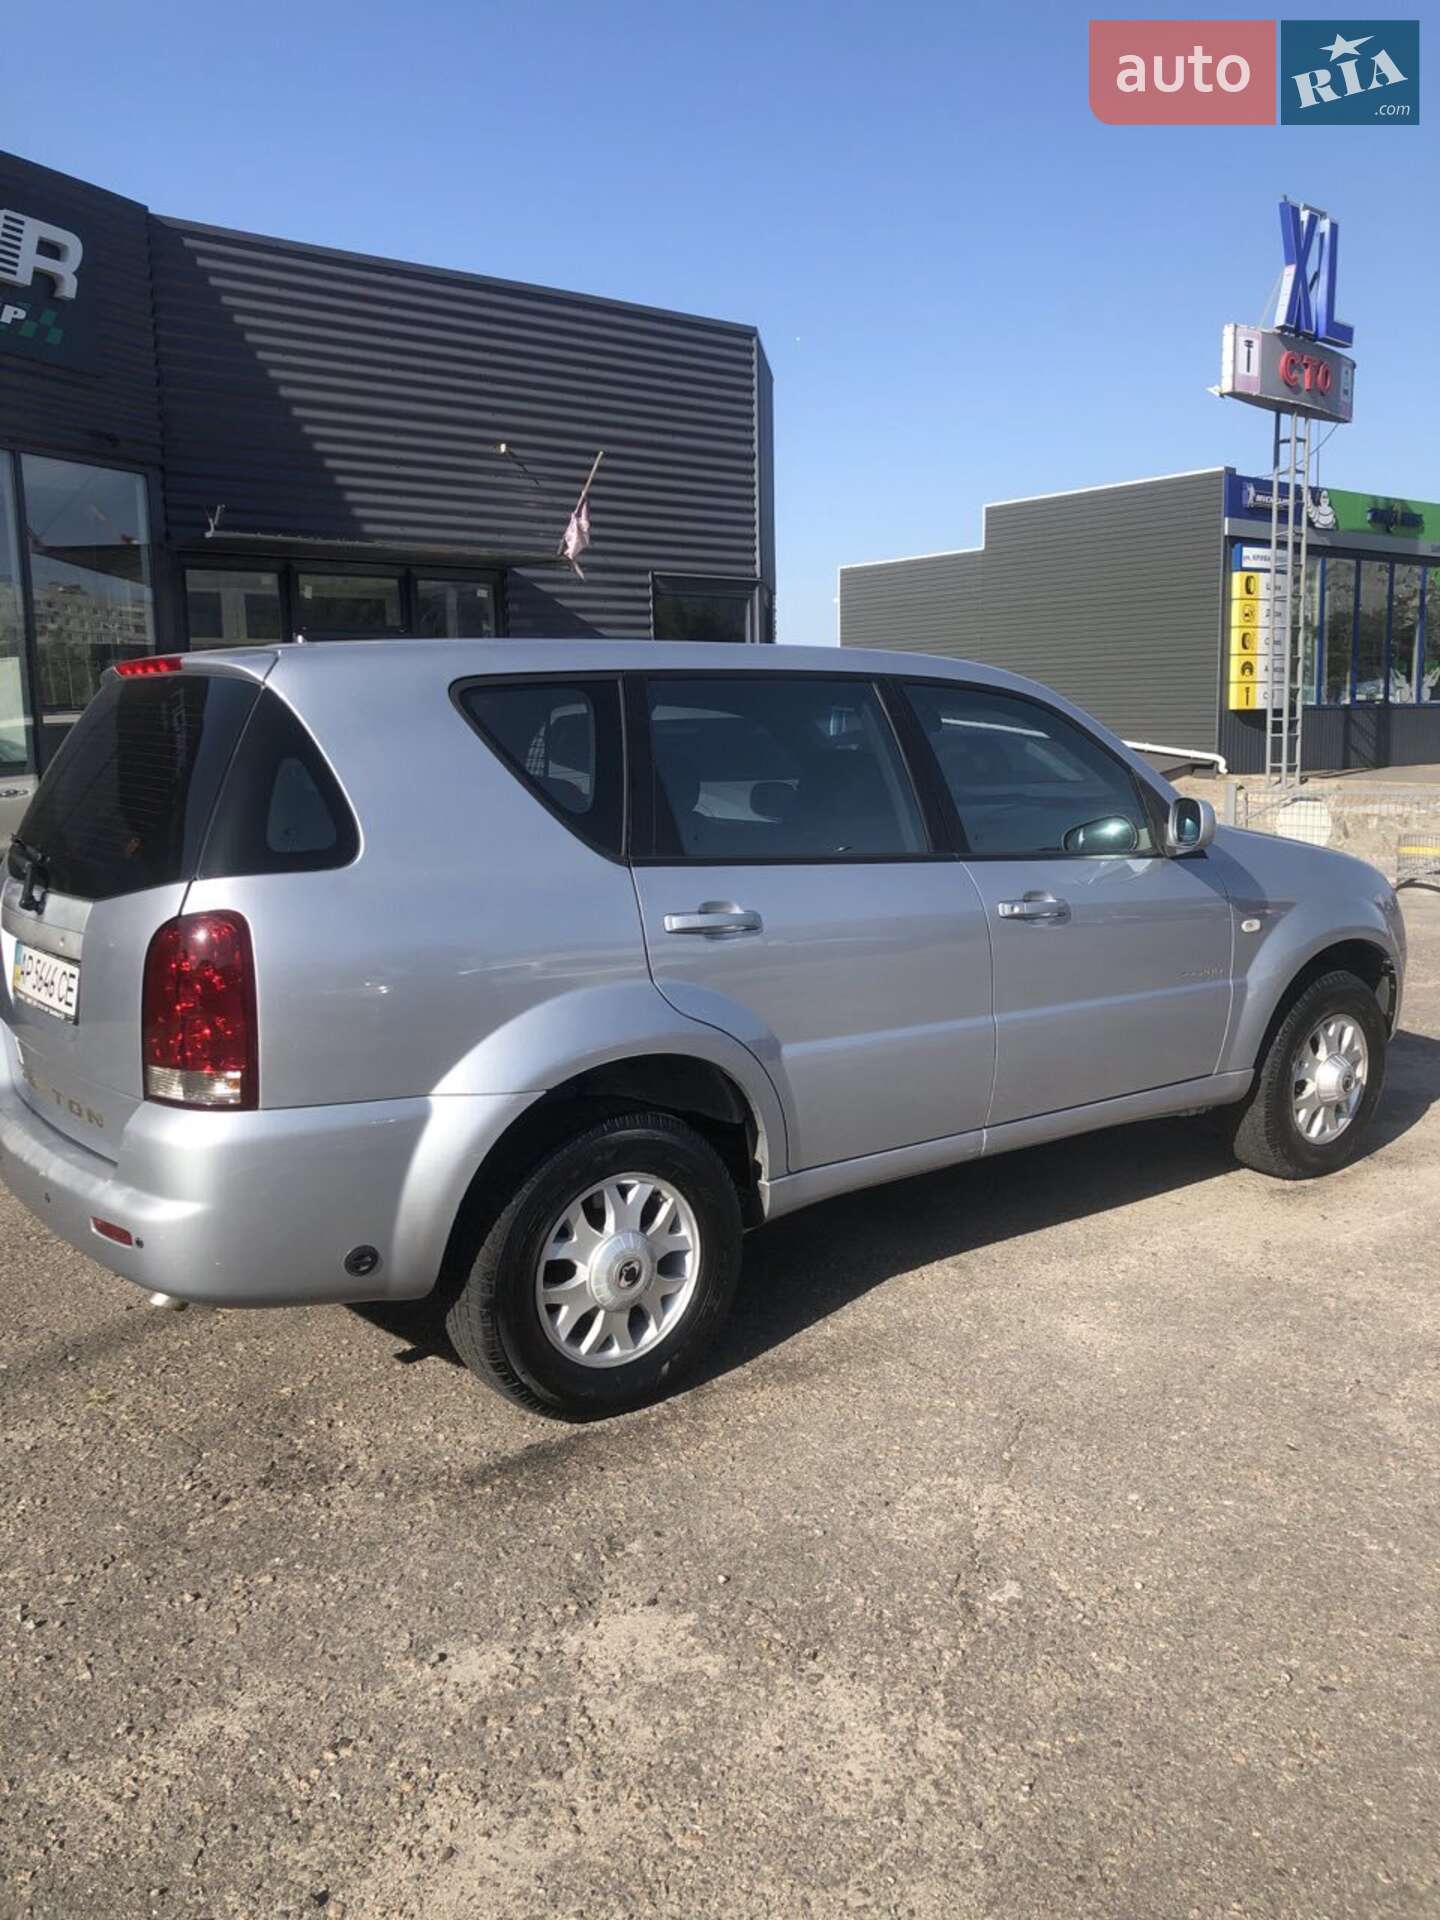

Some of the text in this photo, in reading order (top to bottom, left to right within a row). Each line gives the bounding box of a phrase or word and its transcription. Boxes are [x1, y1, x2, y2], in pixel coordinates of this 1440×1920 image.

[1274, 201, 1355, 348] XL
[1279, 350, 1333, 397] СТО
[1255, 493, 1294, 506] MICHLI
[58, 970, 77, 1008] CE
